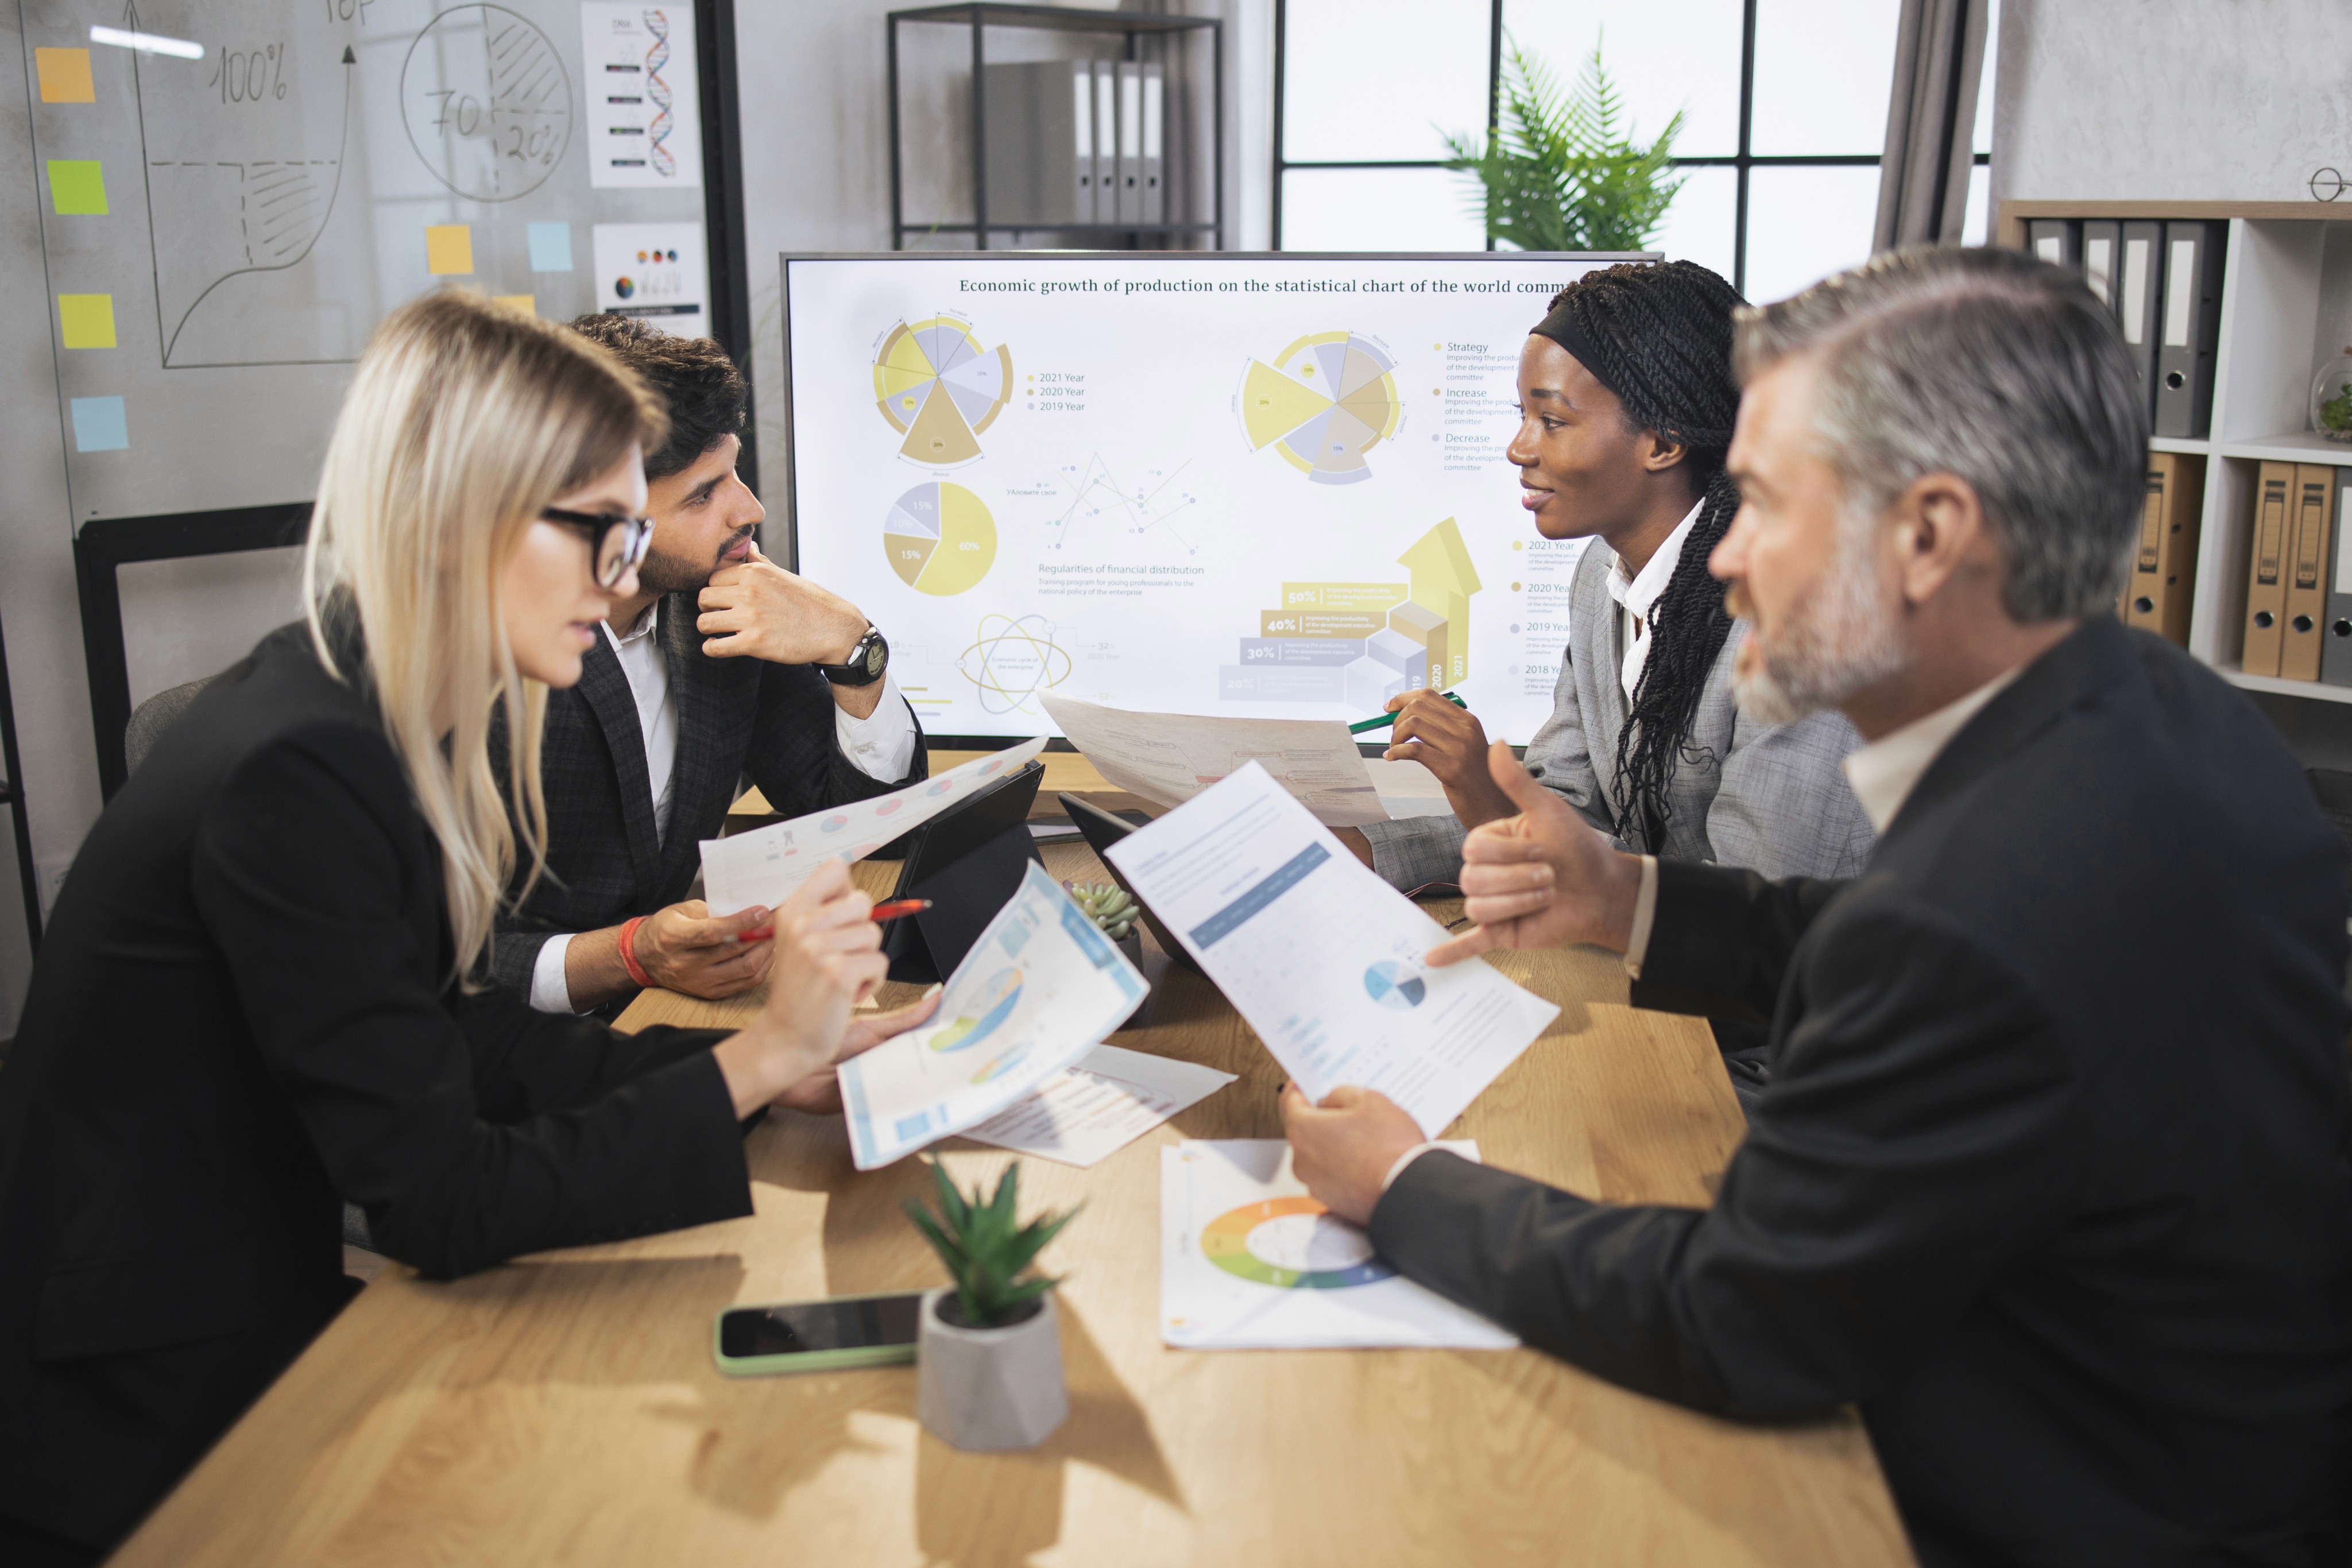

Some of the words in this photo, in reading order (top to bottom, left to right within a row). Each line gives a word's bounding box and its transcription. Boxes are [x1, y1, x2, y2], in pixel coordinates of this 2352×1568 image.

[208, 42, 287, 104] 100%
[425, 90, 481, 137] 70
[508, 124, 561, 165] 20%
[960, 280, 1036, 292] Economic
[1041, 279, 1099, 295] growth
[1104, 278, 1120, 292] of
[1125, 279, 1213, 295] production
[1219, 282, 1238, 292] on
[1244, 279, 1270, 292] the
[1275, 279, 1357, 293] statistical
[1363, 280, 1405, 293] chart
[1411, 279, 1428, 292] of
[1432, 280, 1458, 293] the
[1464, 280, 1511, 293] world
[1372, 335, 1390, 349] decrease
[1448, 342, 1488, 354] Strategy
[1446, 354, 1483, 362] Improving
[1468, 364, 1514, 373] development
[1040, 374, 1061, 382] 2021
[1065, 374, 1085, 382] Year
[1040, 388, 1062, 396] 2020
[1065, 388, 1085, 396] Year
[1446, 388, 1487, 397] Increase
[1040, 403, 1062, 411] 2019
[1065, 402, 1085, 411] Year
[1445, 398, 1481, 406] Improving
[1467, 408, 1512, 417] development
[1446, 433, 1490, 443] Decrease
[1445, 444, 1480, 452] Improving
[913, 501, 933, 510] 15%
[893, 519, 913, 528] 10%
[959, 541, 980, 551] 60%
[1529, 541, 1551, 549] 2021
[1554, 541, 1575, 550] Year
[902, 551, 921, 559] 15%
[1039, 564, 1093, 575] Regularities
[1096, 564, 1105, 574] of
[1108, 564, 1147, 574] financial
[1149, 565, 1204, 574] distribution
[1039, 578, 1065, 587] Training
[1130, 579, 1173, 587] professionals
[1528, 584, 1551, 592] 2020
[1289, 591, 1316, 604] 50%
[1267, 619, 1296, 632] 40%
[1527, 622, 1550, 631] 2019
[1247, 646, 1275, 659] 30%
[1454, 655, 1463, 677] 2021
[1525, 665, 1549, 673] 2018
[1432, 664, 1442, 688] 2020
[1227, 677, 1254, 689] 20%
